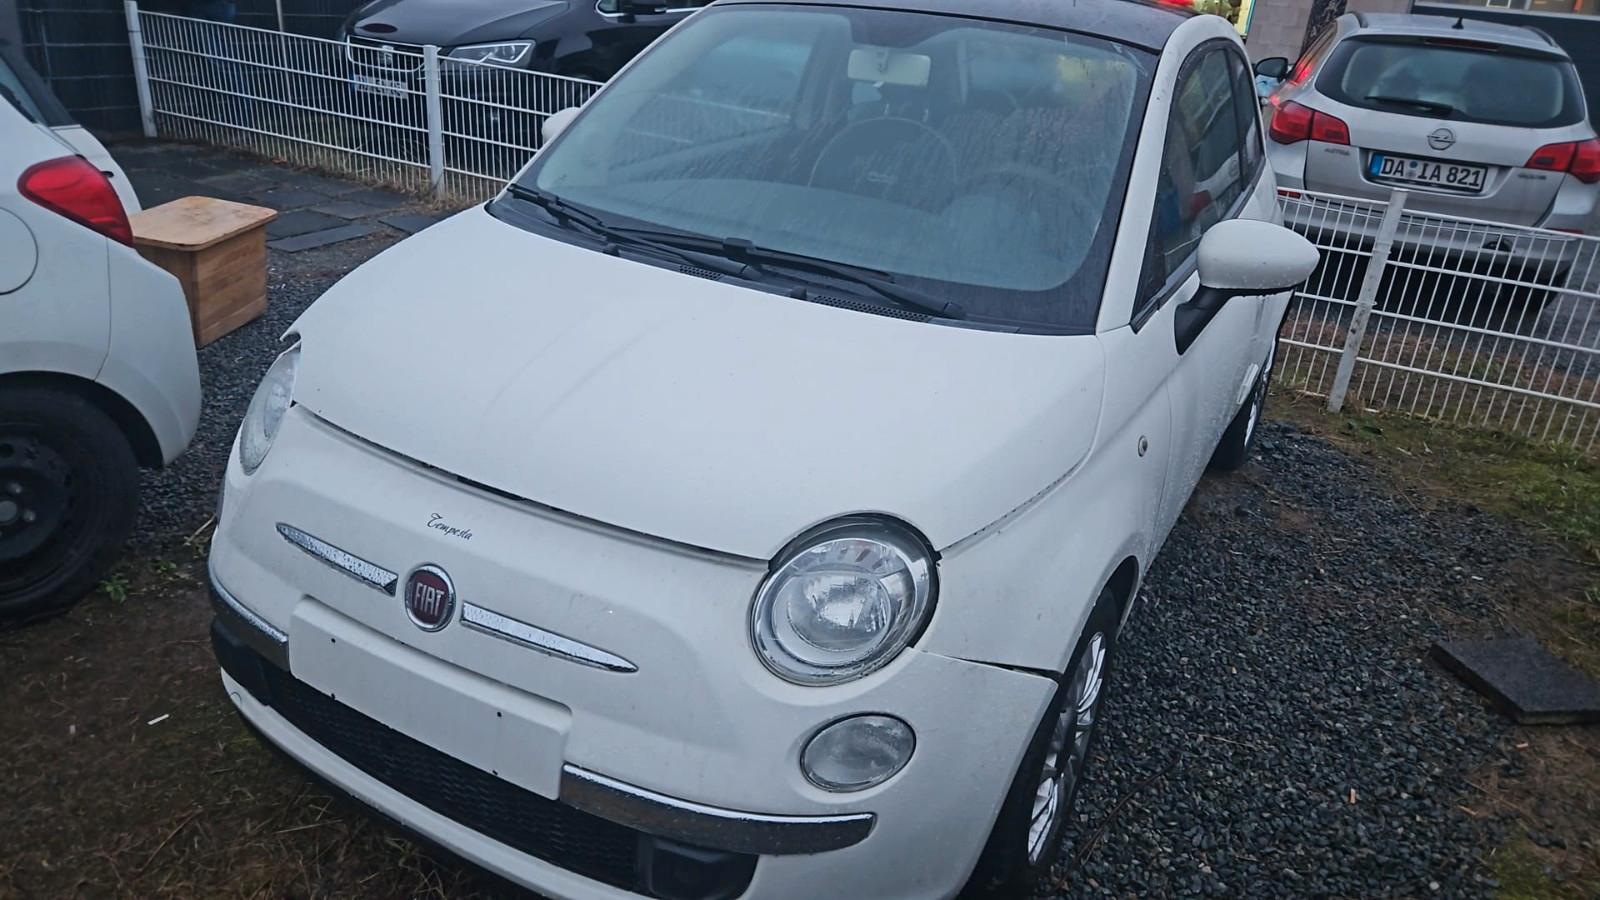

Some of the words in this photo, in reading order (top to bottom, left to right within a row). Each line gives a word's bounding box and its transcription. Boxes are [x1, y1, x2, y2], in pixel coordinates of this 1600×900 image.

[1381, 158, 1405, 177] DA
[1418, 163, 1441, 181] IA
[1447, 167, 1480, 187] 821
[427, 512, 473, 541] Tempesta
[414, 582, 445, 616] FIAT
